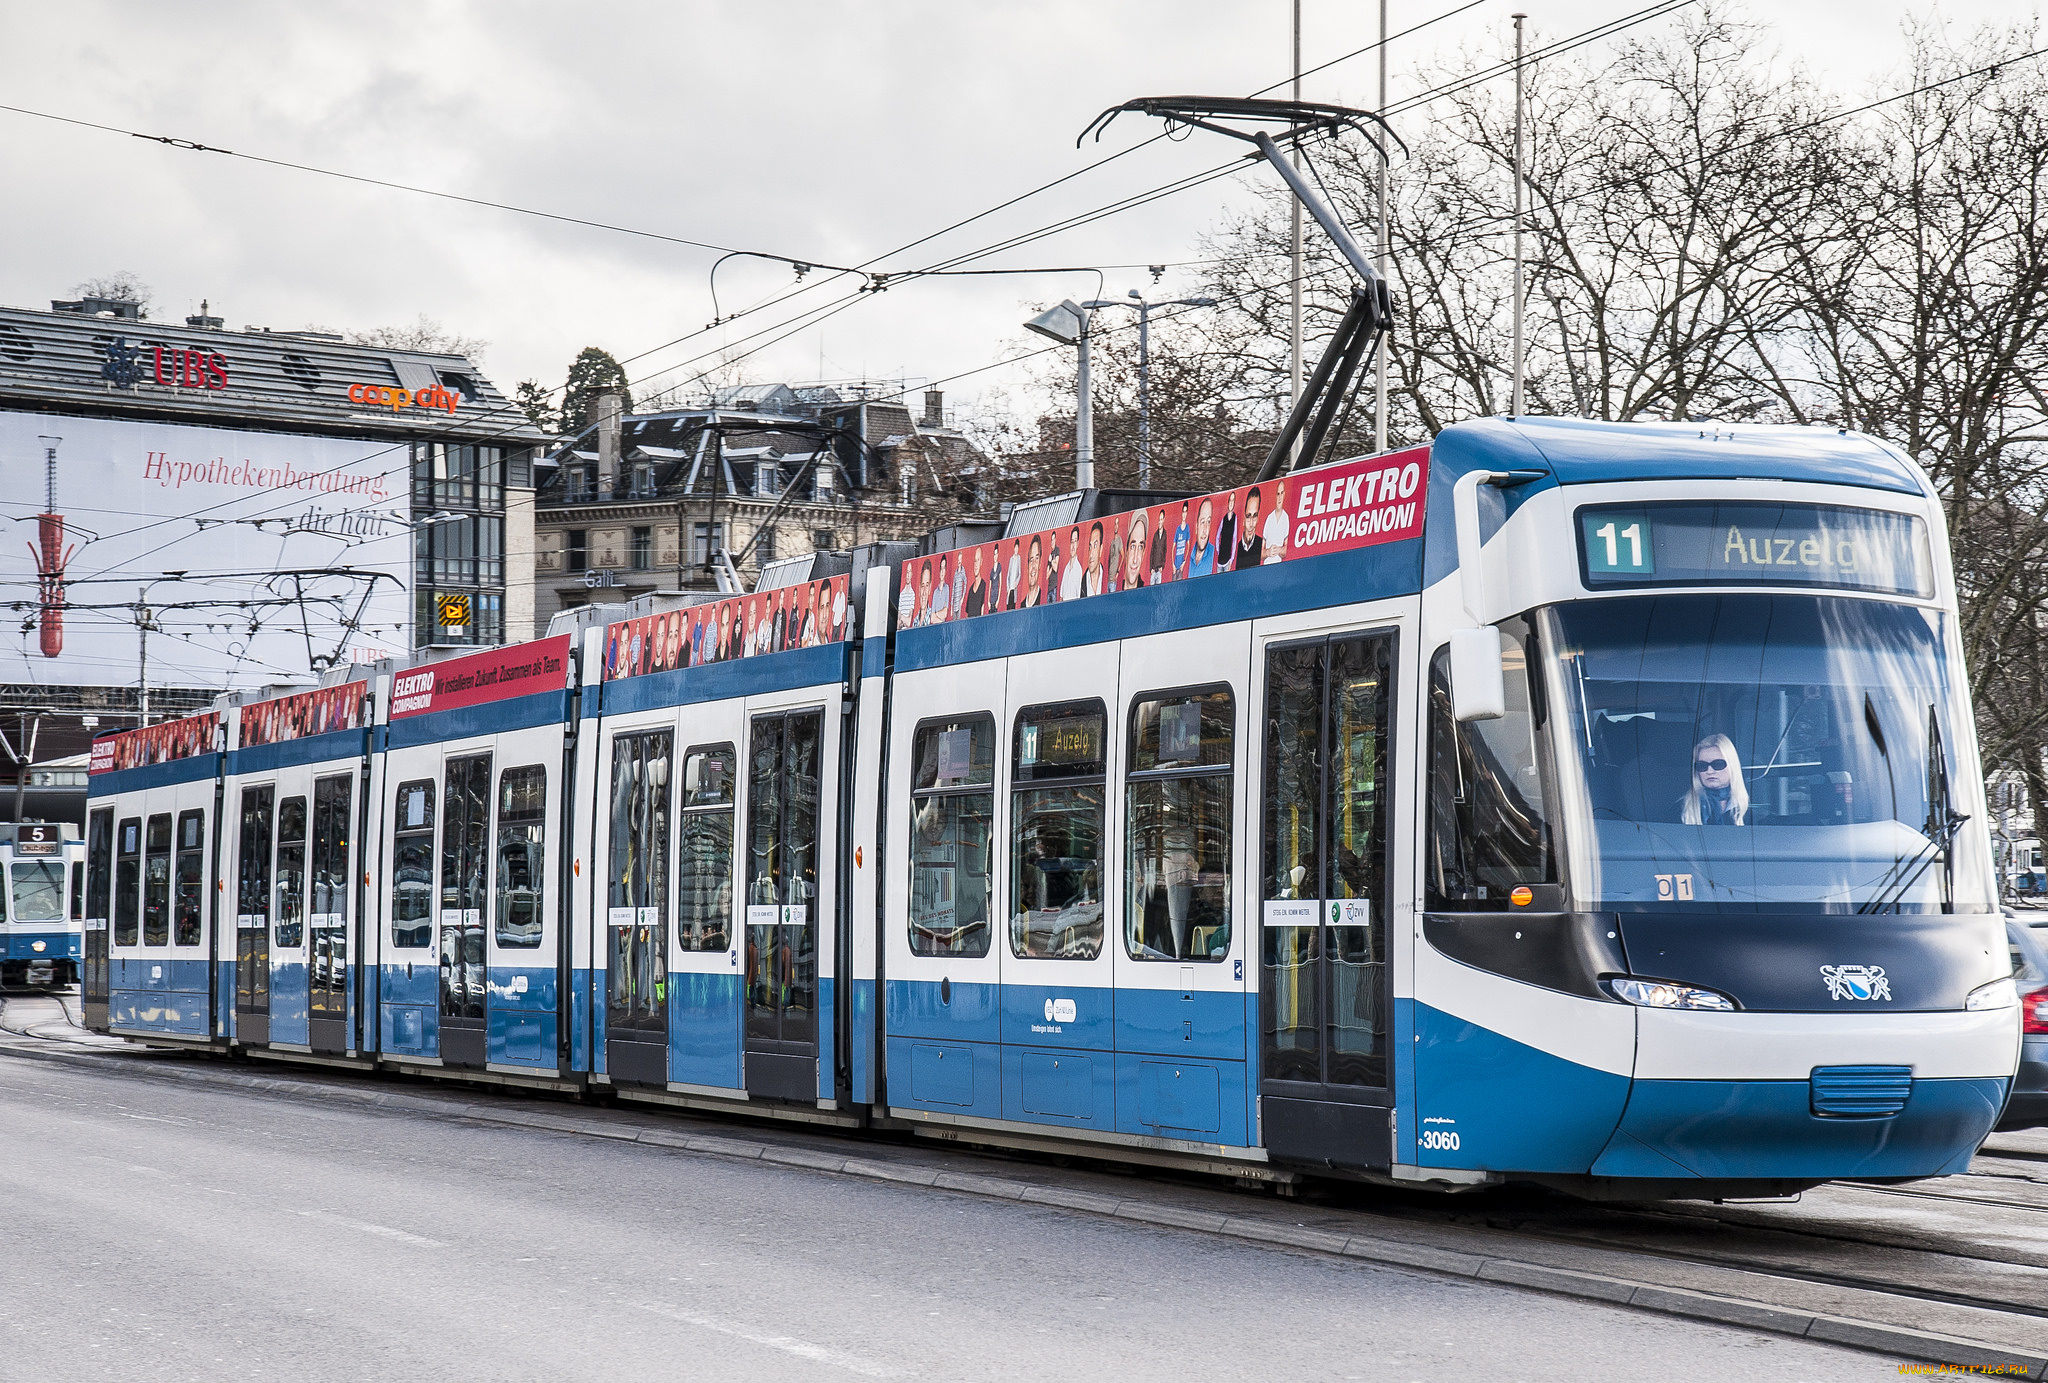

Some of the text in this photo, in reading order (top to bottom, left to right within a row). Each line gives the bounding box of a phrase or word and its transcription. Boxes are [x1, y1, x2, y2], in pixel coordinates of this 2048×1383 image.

[151, 346, 228, 391] UBS
[348, 383, 460, 414] coop city
[1296, 462, 1420, 519] ELEKTRO
[299, 504, 334, 532] die
[1294, 501, 1416, 548] COMPAGNONI
[1596, 522, 1861, 574] 11 Auzelg
[532, 657, 542, 677] als
[394, 671, 435, 698] ELEKTRO
[392, 693, 432, 714] COMPAGNONI
[1026, 724, 1089, 759] 11 Auzelg
[31, 827, 45, 842] 5
[1423, 1130, 1460, 1150] 3060
